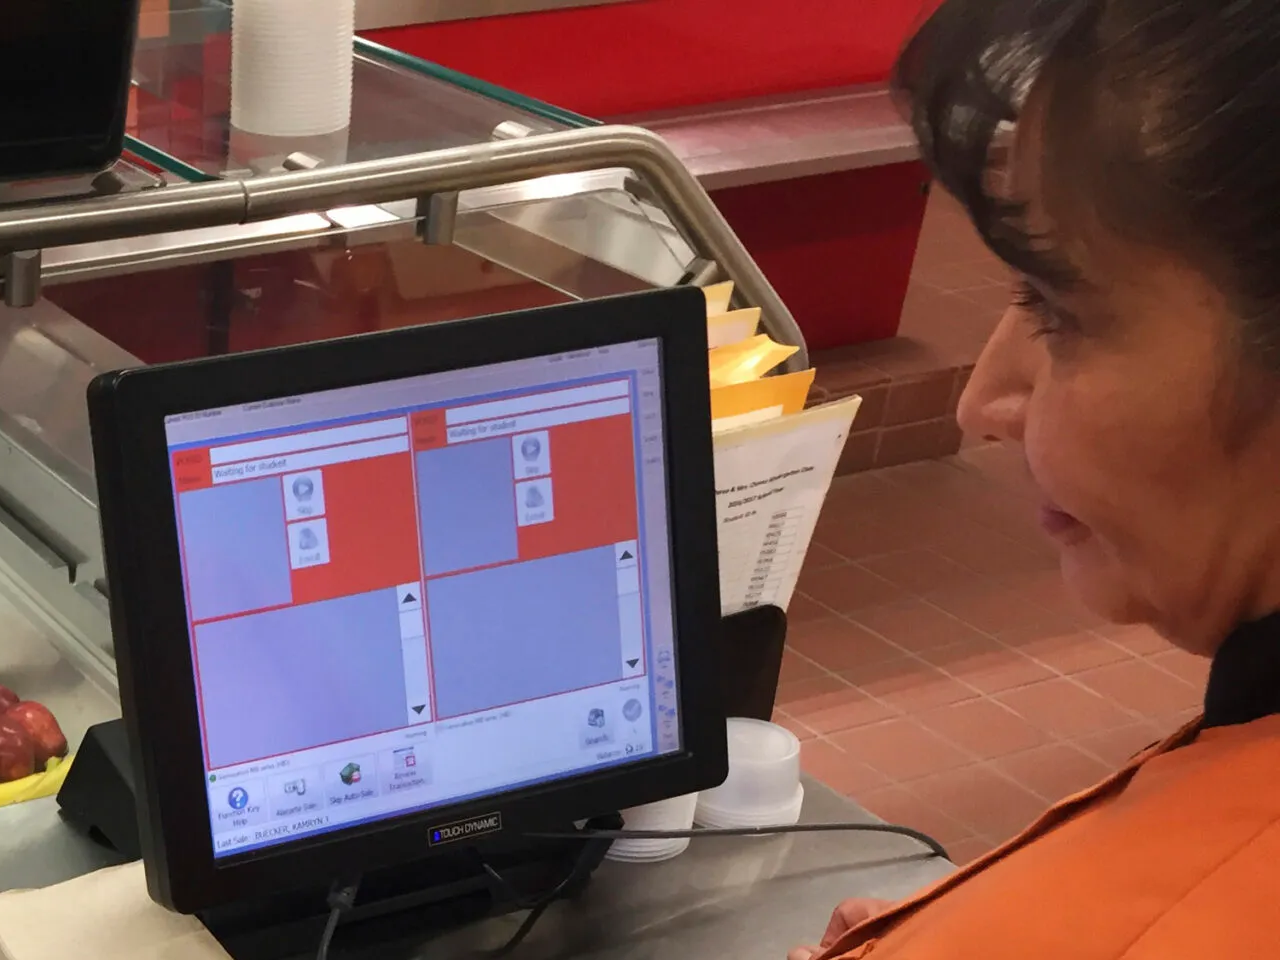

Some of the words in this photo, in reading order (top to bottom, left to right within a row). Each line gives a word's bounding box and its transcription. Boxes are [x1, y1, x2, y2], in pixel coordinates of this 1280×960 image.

[449, 427, 477, 440] Waiting
[490, 420, 517, 433] student
[215, 464, 244, 479] Waiting
[245, 462, 256, 473] for
[258, 458, 287, 471] student
[440, 826, 464, 839] TOUCH
[464, 817, 498, 833] DYNAMIC
[217, 836, 231, 849] Last
